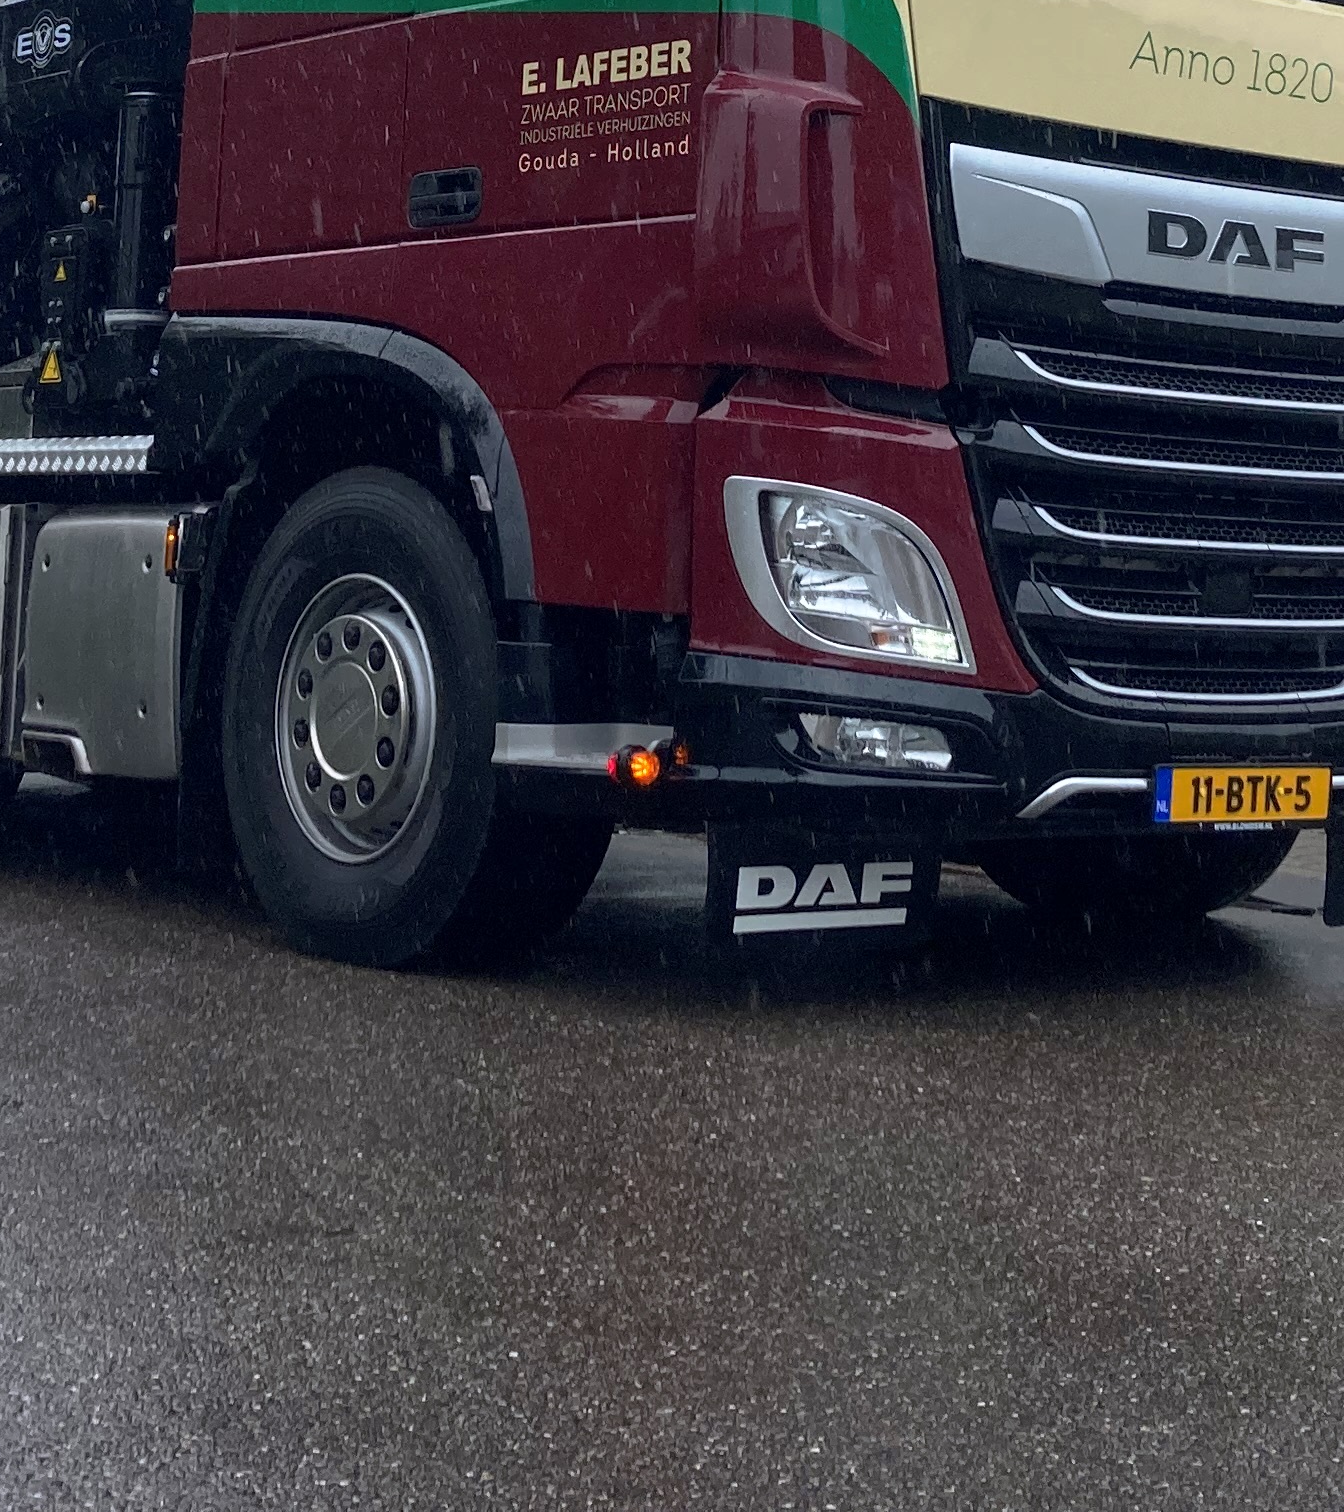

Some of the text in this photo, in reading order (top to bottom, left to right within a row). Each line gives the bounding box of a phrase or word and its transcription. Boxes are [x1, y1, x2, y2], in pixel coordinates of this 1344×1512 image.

[522, 39, 692, 96] E. LAFEBER
[1128, 30, 1334, 104] Anno 1820
[520, 82, 692, 125] ZWAAR TRANSPORT
[596, 110, 691, 136] VERHUIZINGEN
[518, 147, 579, 173] Gouda
[607, 133, 690, 163] Holland
[1146, 208, 1325, 273] DAF
[1156, 775, 1312, 814] NL 11-BTK-5
[735, 860, 914, 911] DAF
